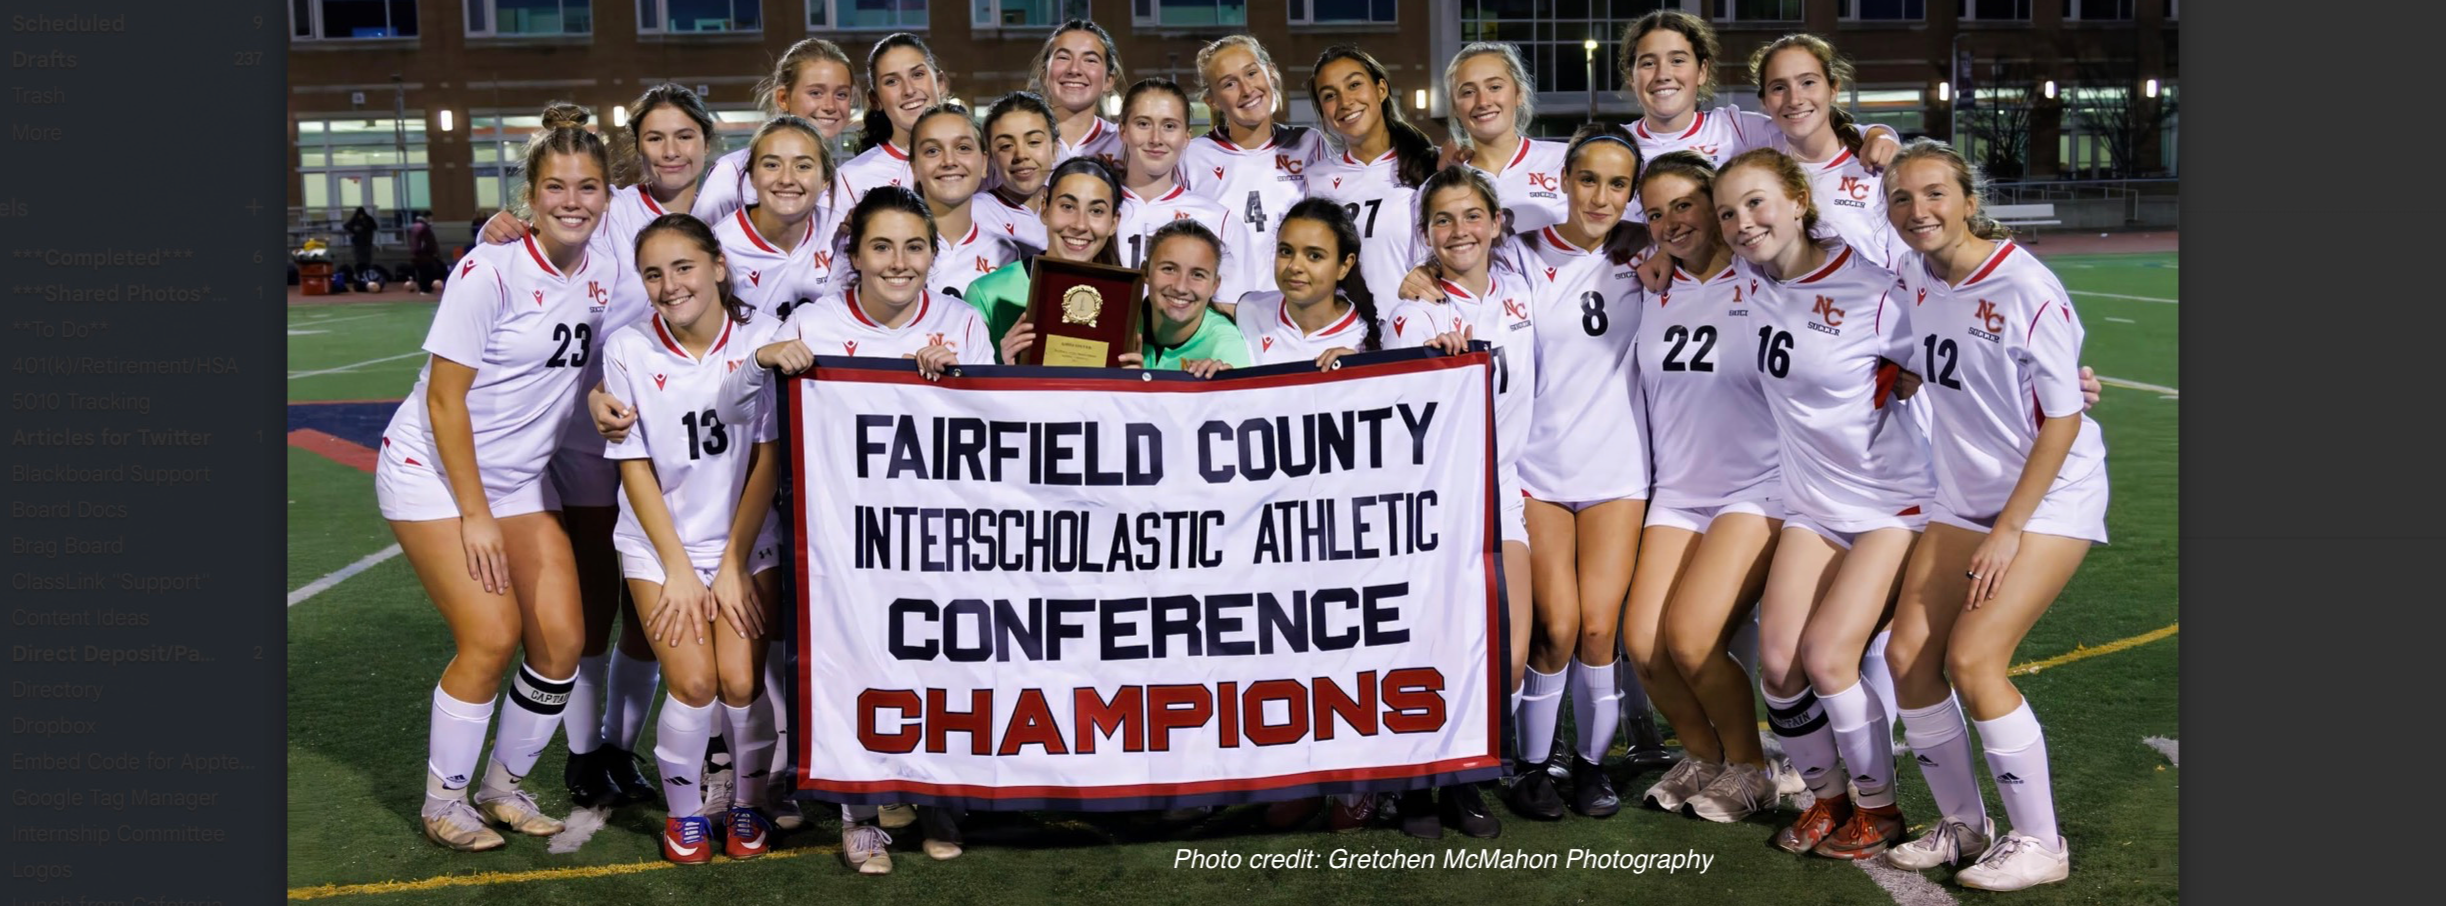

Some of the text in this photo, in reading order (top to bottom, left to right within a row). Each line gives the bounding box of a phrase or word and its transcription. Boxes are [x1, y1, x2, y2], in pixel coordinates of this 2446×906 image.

[12, 14, 124, 31] Scheduled
[254, 16, 264, 30] 9
[12, 49, 77, 67] Drafts
[235, 51, 264, 66] 237
[12, 86, 65, 104] Trash
[12, 124, 62, 141] More
[1275, 154, 1303, 174] NC
[1528, 172, 1558, 192] NC
[1838, 177, 1870, 200] NC
[1243, 190, 1267, 232] 4
[1834, 199, 1866, 208] SOCCER
[253, 250, 263, 264] 6
[976, 255, 998, 273] N
[256, 286, 263, 300] 1
[588, 281, 608, 305] NC
[1502, 298, 1528, 320] NC
[1579, 290, 1609, 337] 8
[1812, 295, 1845, 326] NC
[1974, 298, 2005, 333] NC
[1807, 321, 1840, 336] SOCCER
[1968, 326, 2000, 344] SOCCER
[545, 322, 592, 368] 23
[1662, 325, 1718, 373] 22
[1757, 325, 1795, 379] 16
[12, 356, 239, 376] 401(k)/Retirement/HSA
[1923, 333, 1962, 391] 12
[12, 392, 151, 414] 5010 Tracking
[12, 428, 212, 445] Articles for Twitter
[256, 430, 263, 443] 1
[682, 408, 729, 461] 13
[855, 402, 1438, 486] FAIRFIELD COUNTY
[12, 464, 211, 486] Blackboard Support
[12, 500, 128, 518] Board Docs
[855, 489, 1438, 573] INTERSCHOLASTIC ATHLETIC
[12, 536, 123, 558] Brag Board
[12, 572, 106, 590] ClassLink
[12, 608, 150, 626] Content Ideas
[888, 582, 1411, 662] CONFERENCE
[12, 644, 77, 662] Direct
[253, 646, 263, 660] 2
[12, 680, 103, 702] Directory
[856, 667, 1447, 756] CHAMPIONS
[12, 716, 96, 737] Dropbox
[12, 752, 81, 770] Embed
[87, 752, 140, 770] Code
[146, 751, 174, 770] for
[12, 788, 218, 810] Google Tag Manager
[12, 824, 225, 846] Internship Committee
[12, 862, 73, 882] Logos
